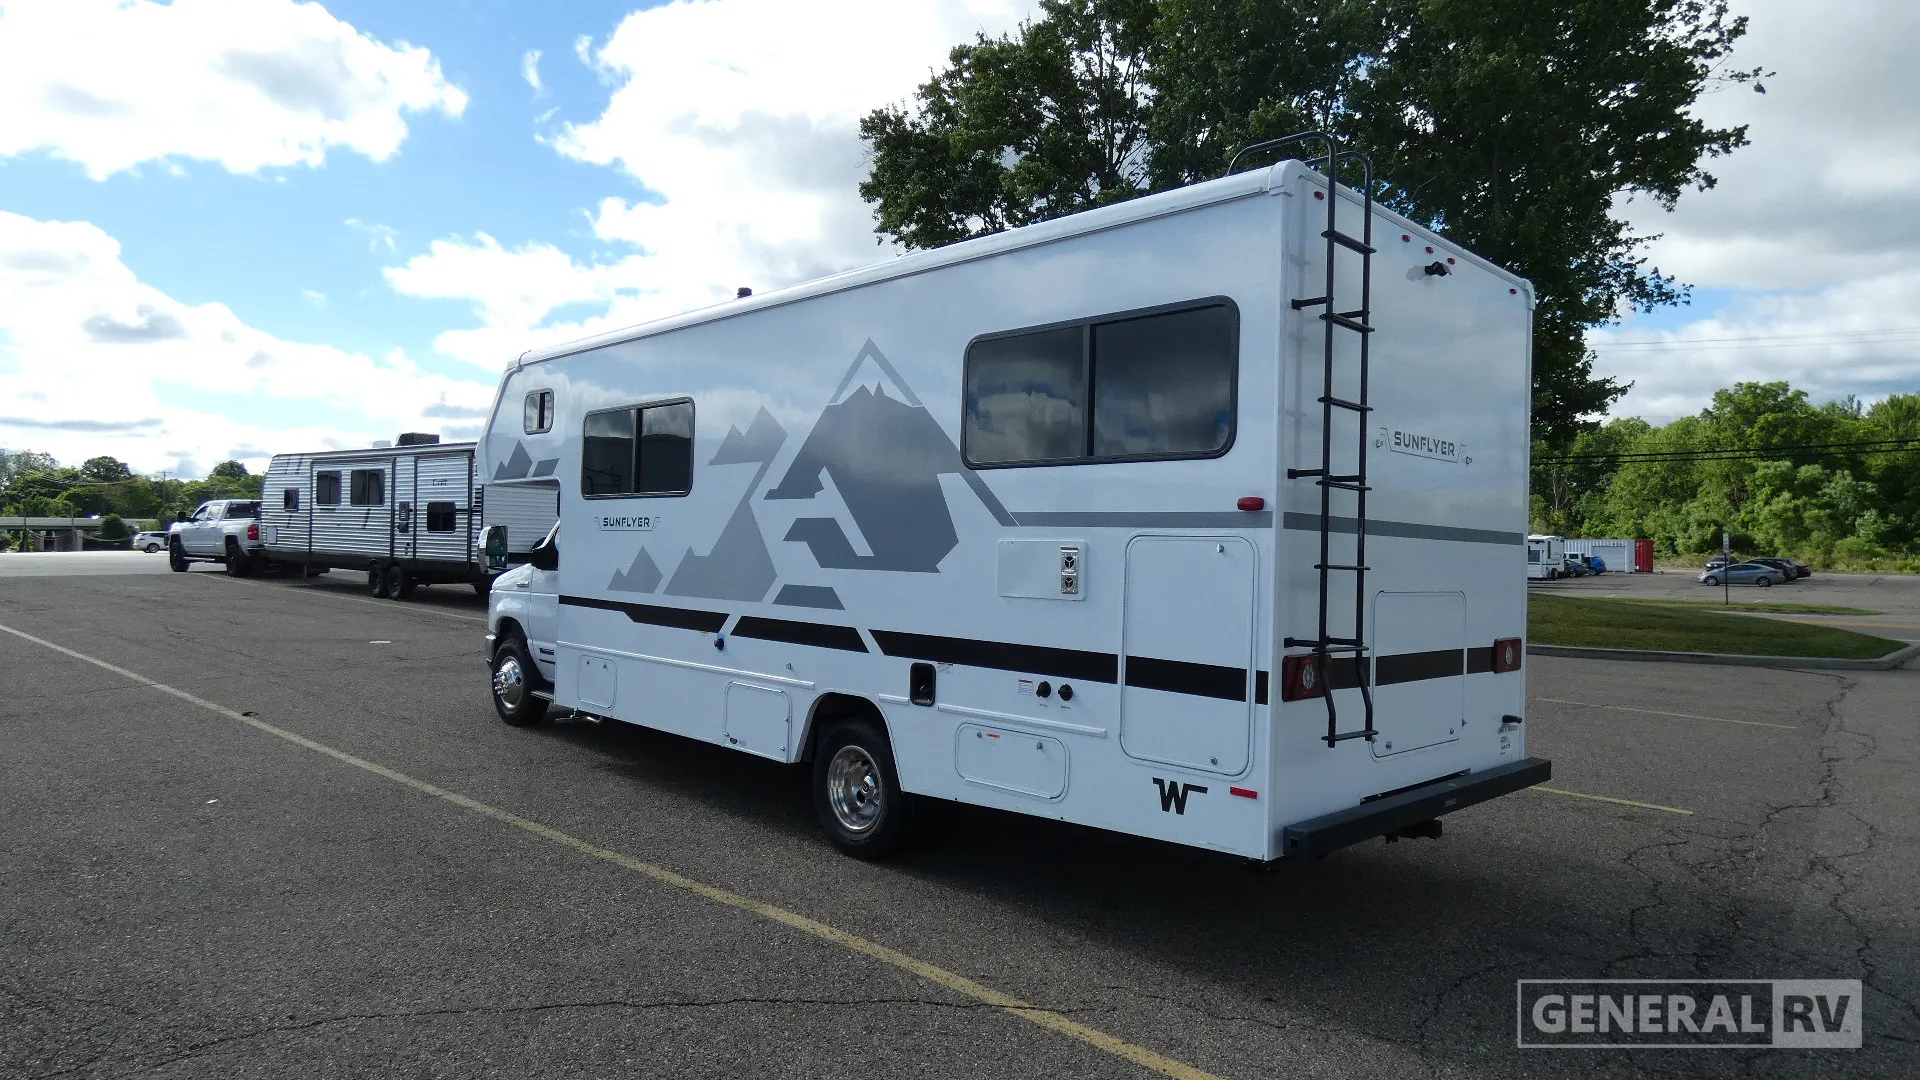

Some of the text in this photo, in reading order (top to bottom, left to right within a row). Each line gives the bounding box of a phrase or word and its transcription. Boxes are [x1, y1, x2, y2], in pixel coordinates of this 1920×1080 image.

[1394, 431, 1455, 457] SUNFLYER
[603, 516, 650, 528] SUNFLYER
[1152, 777, 1208, 815] W
